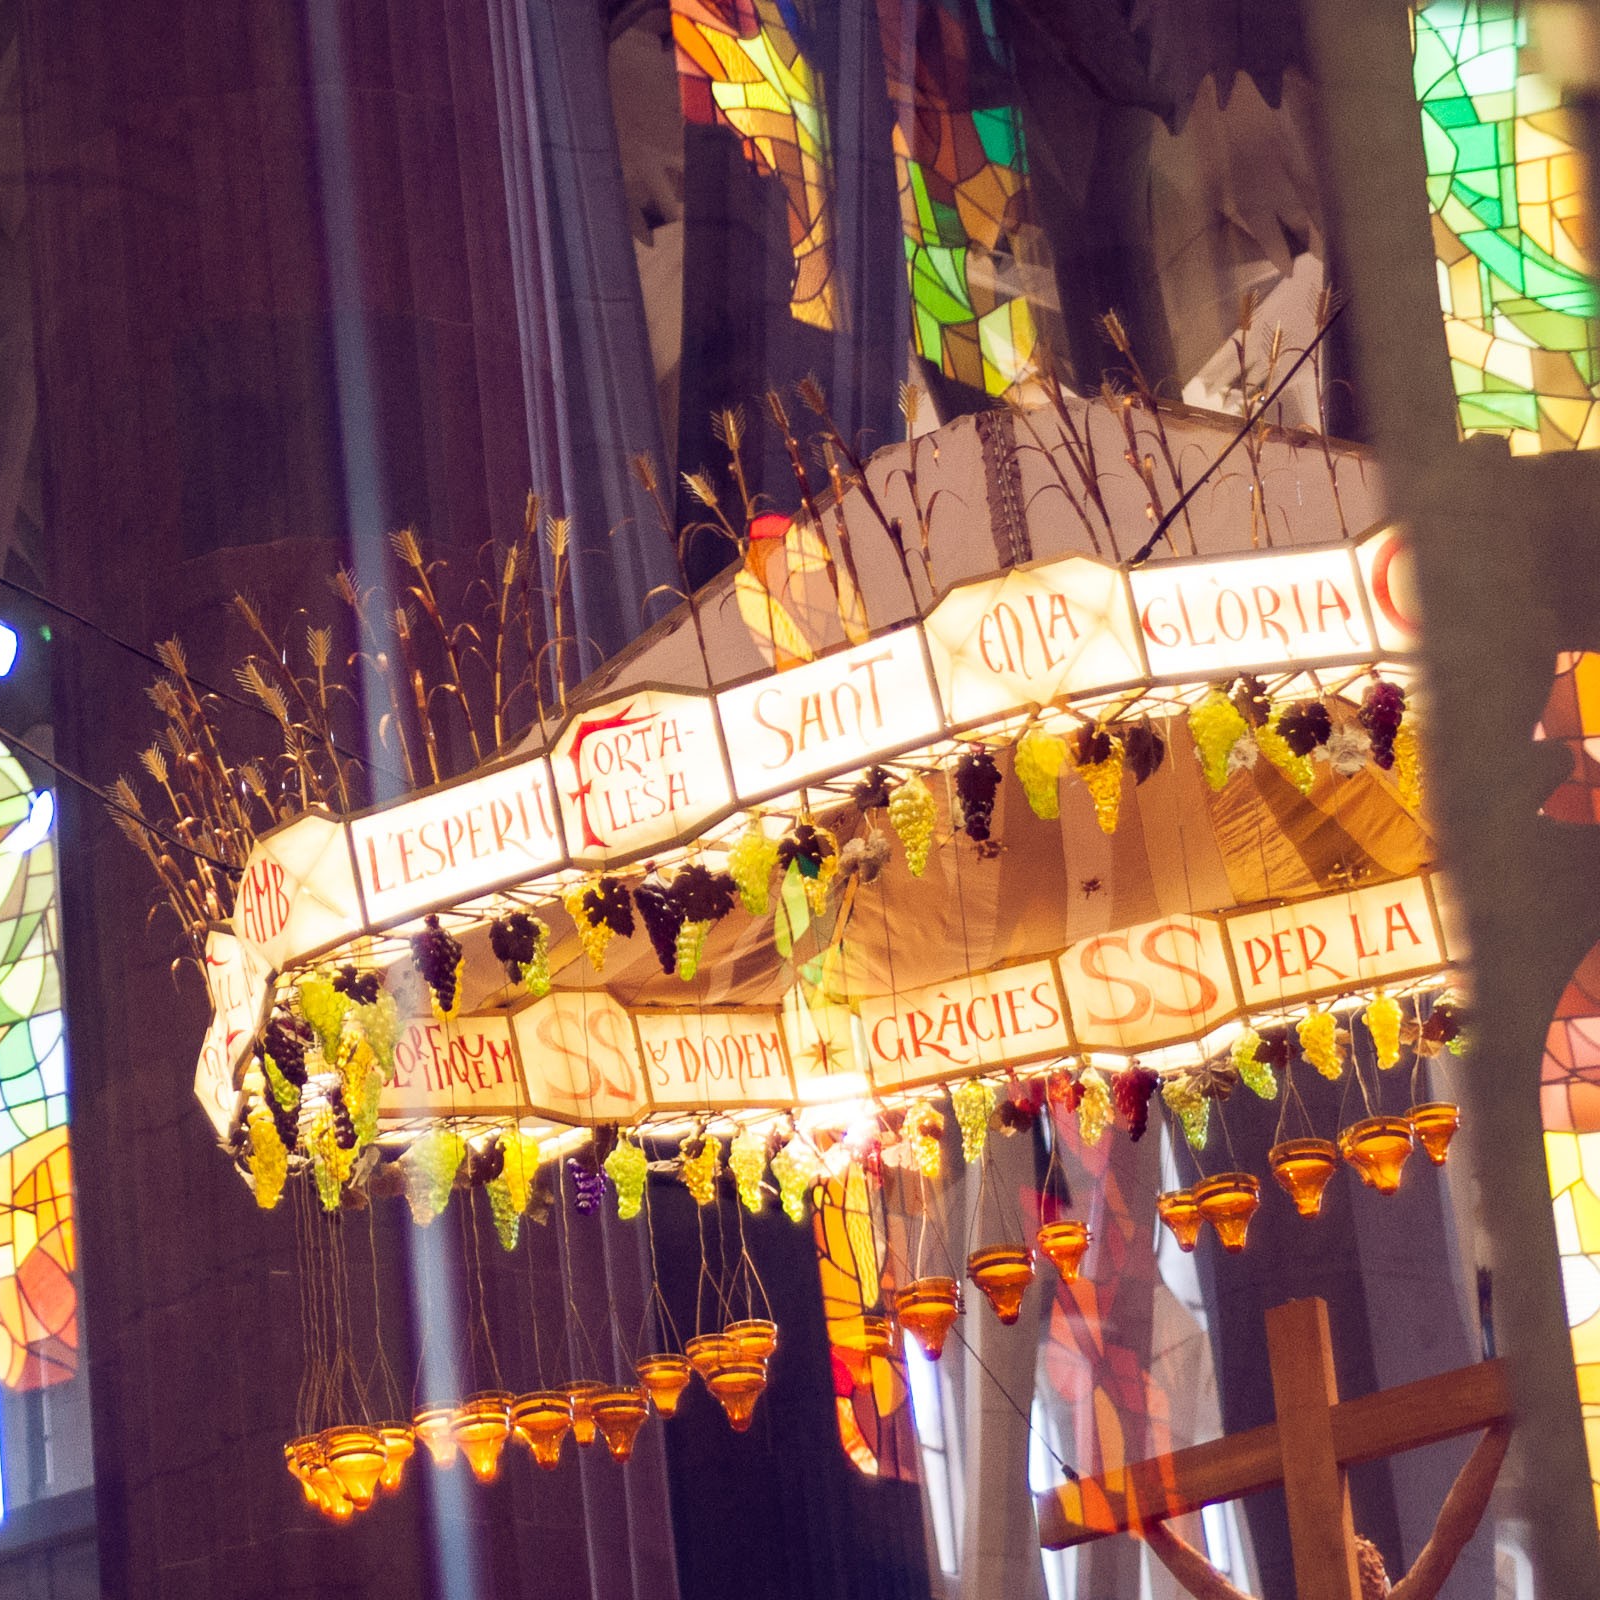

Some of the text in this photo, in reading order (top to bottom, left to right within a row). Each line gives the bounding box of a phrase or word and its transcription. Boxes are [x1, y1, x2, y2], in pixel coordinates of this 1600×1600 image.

[243, 858, 290, 944] AMB
[366, 777, 555, 894] L'ESPERIT
[753, 649, 894, 770] SANT
[1141, 577, 1360, 660] GLÒRIA
[675, 1032, 786, 1094] DONEM
[870, 981, 1060, 1064] GRÀCIES
[1243, 925, 1347, 981] PER
[1350, 902, 1422, 959] LA
[1079, 923, 1218, 1027] SS
[536, 1006, 635, 1099] SS
